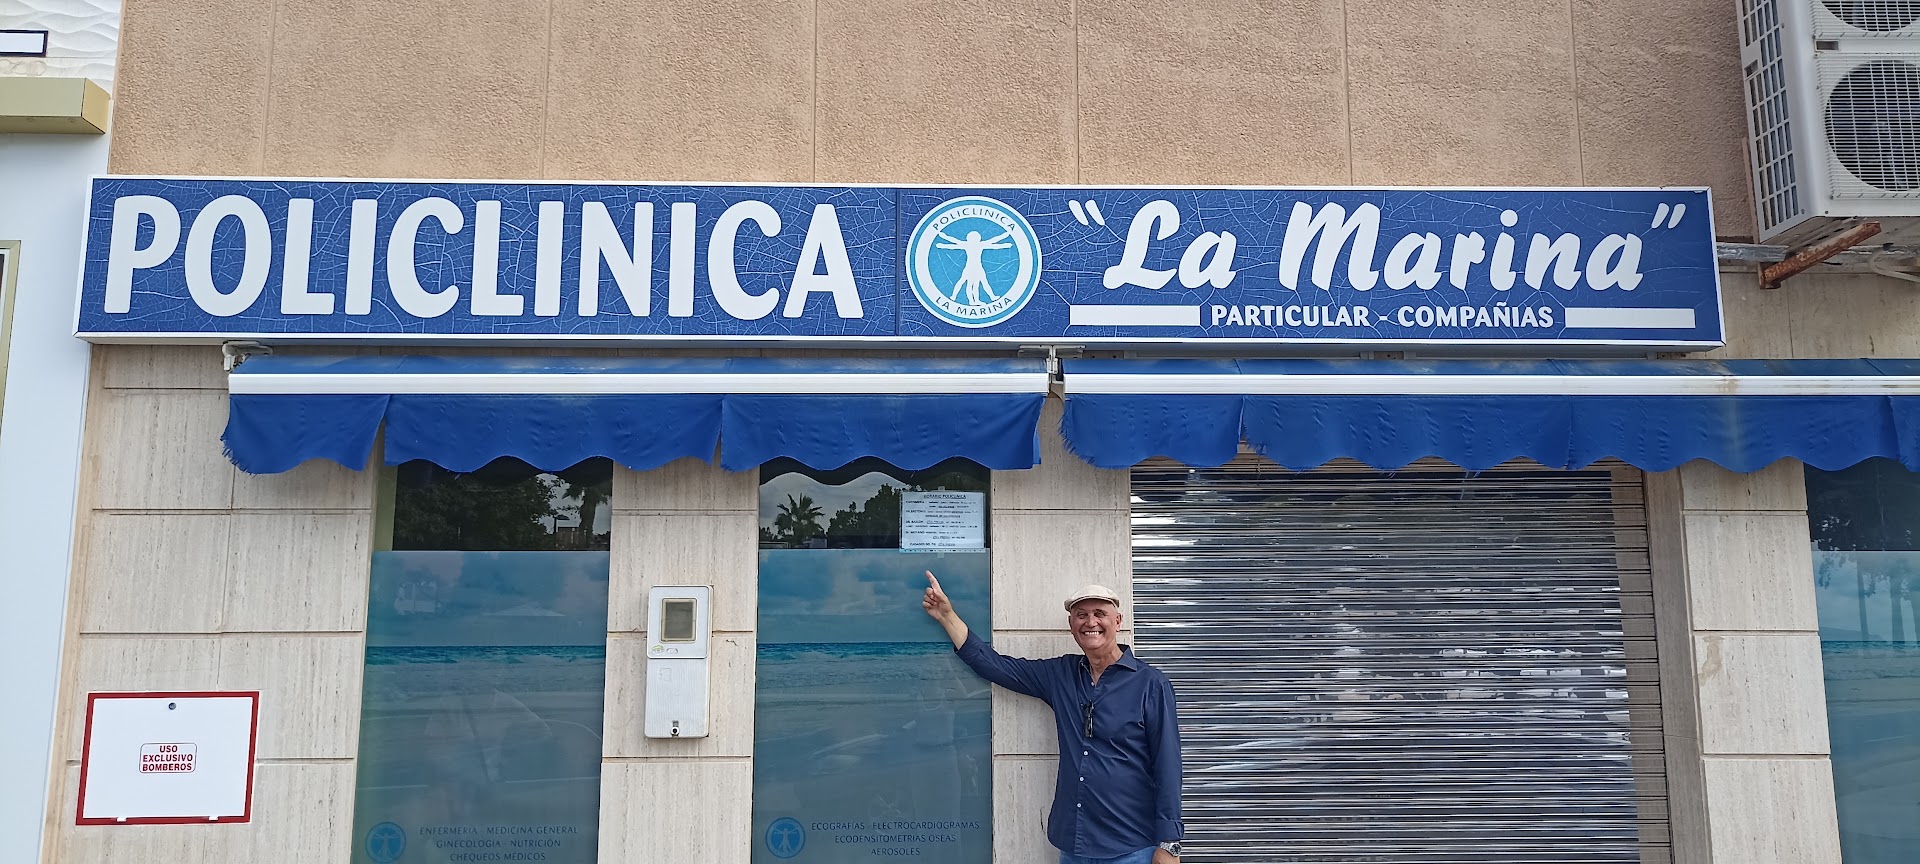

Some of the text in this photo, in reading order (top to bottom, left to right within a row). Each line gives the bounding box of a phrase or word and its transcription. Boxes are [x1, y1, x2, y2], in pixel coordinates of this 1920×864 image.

[933, 207, 1016, 232] POLICLINICA
[103, 194, 864, 321] POLICLINICA
[935, 296, 1013, 317] LA MARINA
[1211, 304, 1370, 328] PARTICULAR
[1396, 300, 1554, 328] COMPAÑIAS
[159, 745, 178, 753] USO
[142, 753, 193, 762] EXCLUSIVO
[142, 763, 192, 772] BOMBEROS
[486, 826, 533, 834] MEDICINA
[536, 826, 578, 834] GENERAL
[872, 821, 980, 830] ELECTROCARDIOGRAMAS
[870, 847, 920, 856] AEROSOLES
[449, 852, 500, 862] CHEQUEOS
